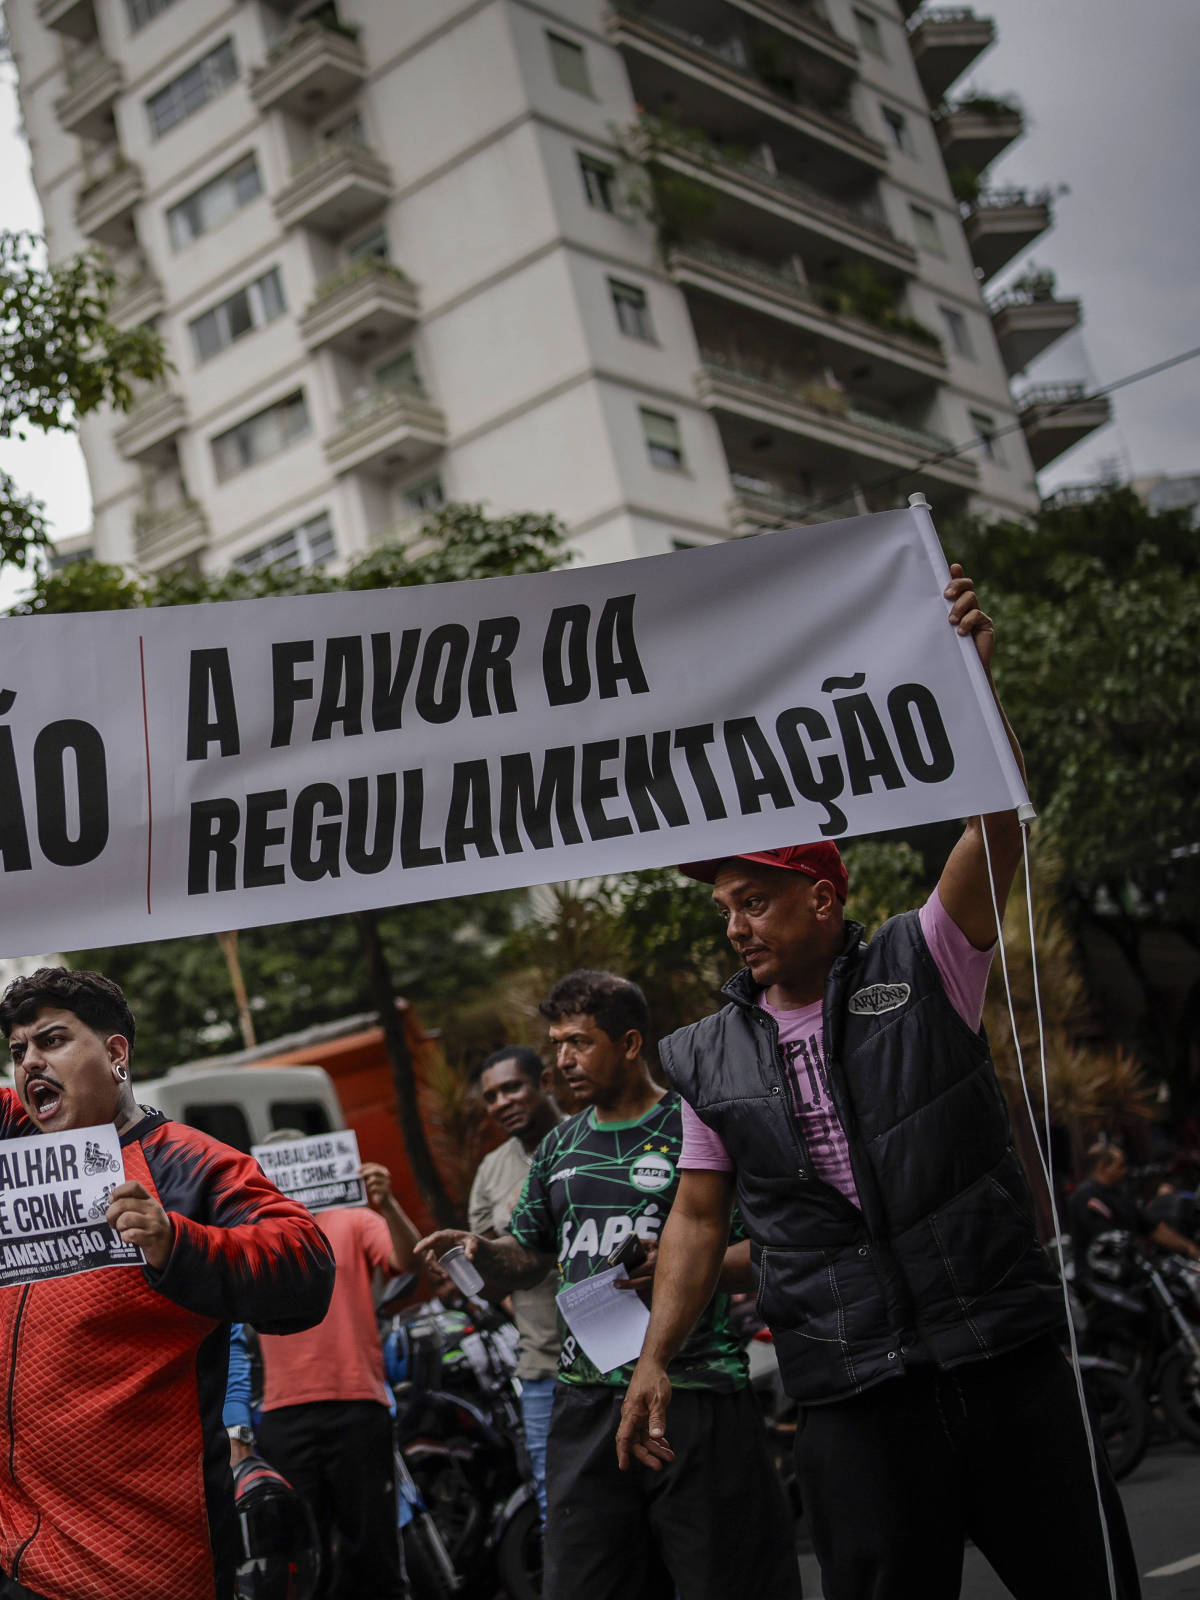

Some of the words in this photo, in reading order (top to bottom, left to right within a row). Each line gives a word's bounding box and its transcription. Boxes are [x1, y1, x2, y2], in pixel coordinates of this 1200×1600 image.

[186, 647, 240, 761] A
[270, 616, 521, 749] FAVOR
[542, 594, 650, 706] DA
[187, 672, 956, 896] REGULAMENTAÇÃO
[13, 1189, 88, 1232] CRIME
